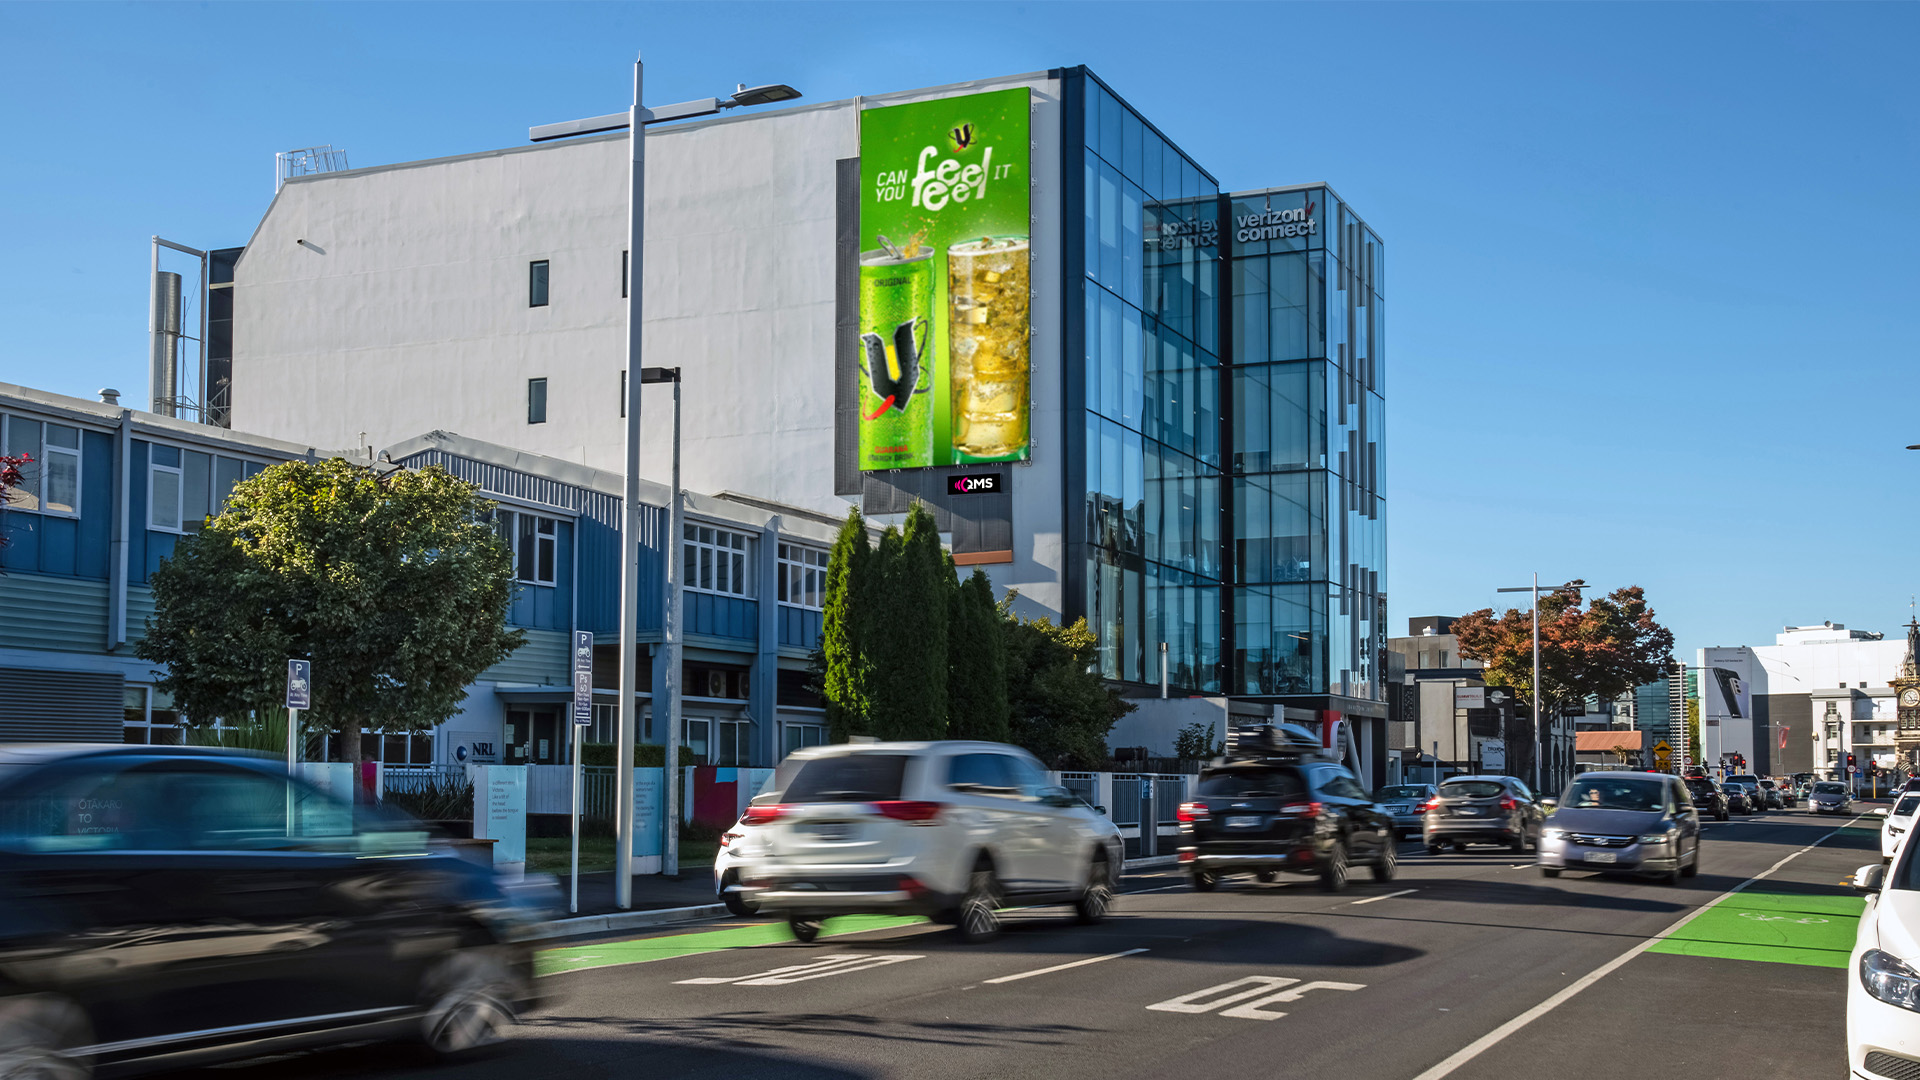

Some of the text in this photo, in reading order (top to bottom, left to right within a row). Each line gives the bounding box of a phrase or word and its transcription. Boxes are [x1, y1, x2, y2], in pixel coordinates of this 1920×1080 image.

[876, 169, 908, 187] CAN
[993, 164, 1012, 181] IT
[875, 186, 905, 203] YOU
[1236, 208, 1306, 229] verizon
[1236, 218, 1316, 243] connect
[874, 276, 912, 288] ORIGINAL
[960, 477, 994, 492] QMS
[581, 634, 588, 645] P
[296, 663, 303, 676] P
[472, 742, 496, 755] NRL
[1657, 761, 1669, 769] 25
[78, 813, 92, 823] TO
